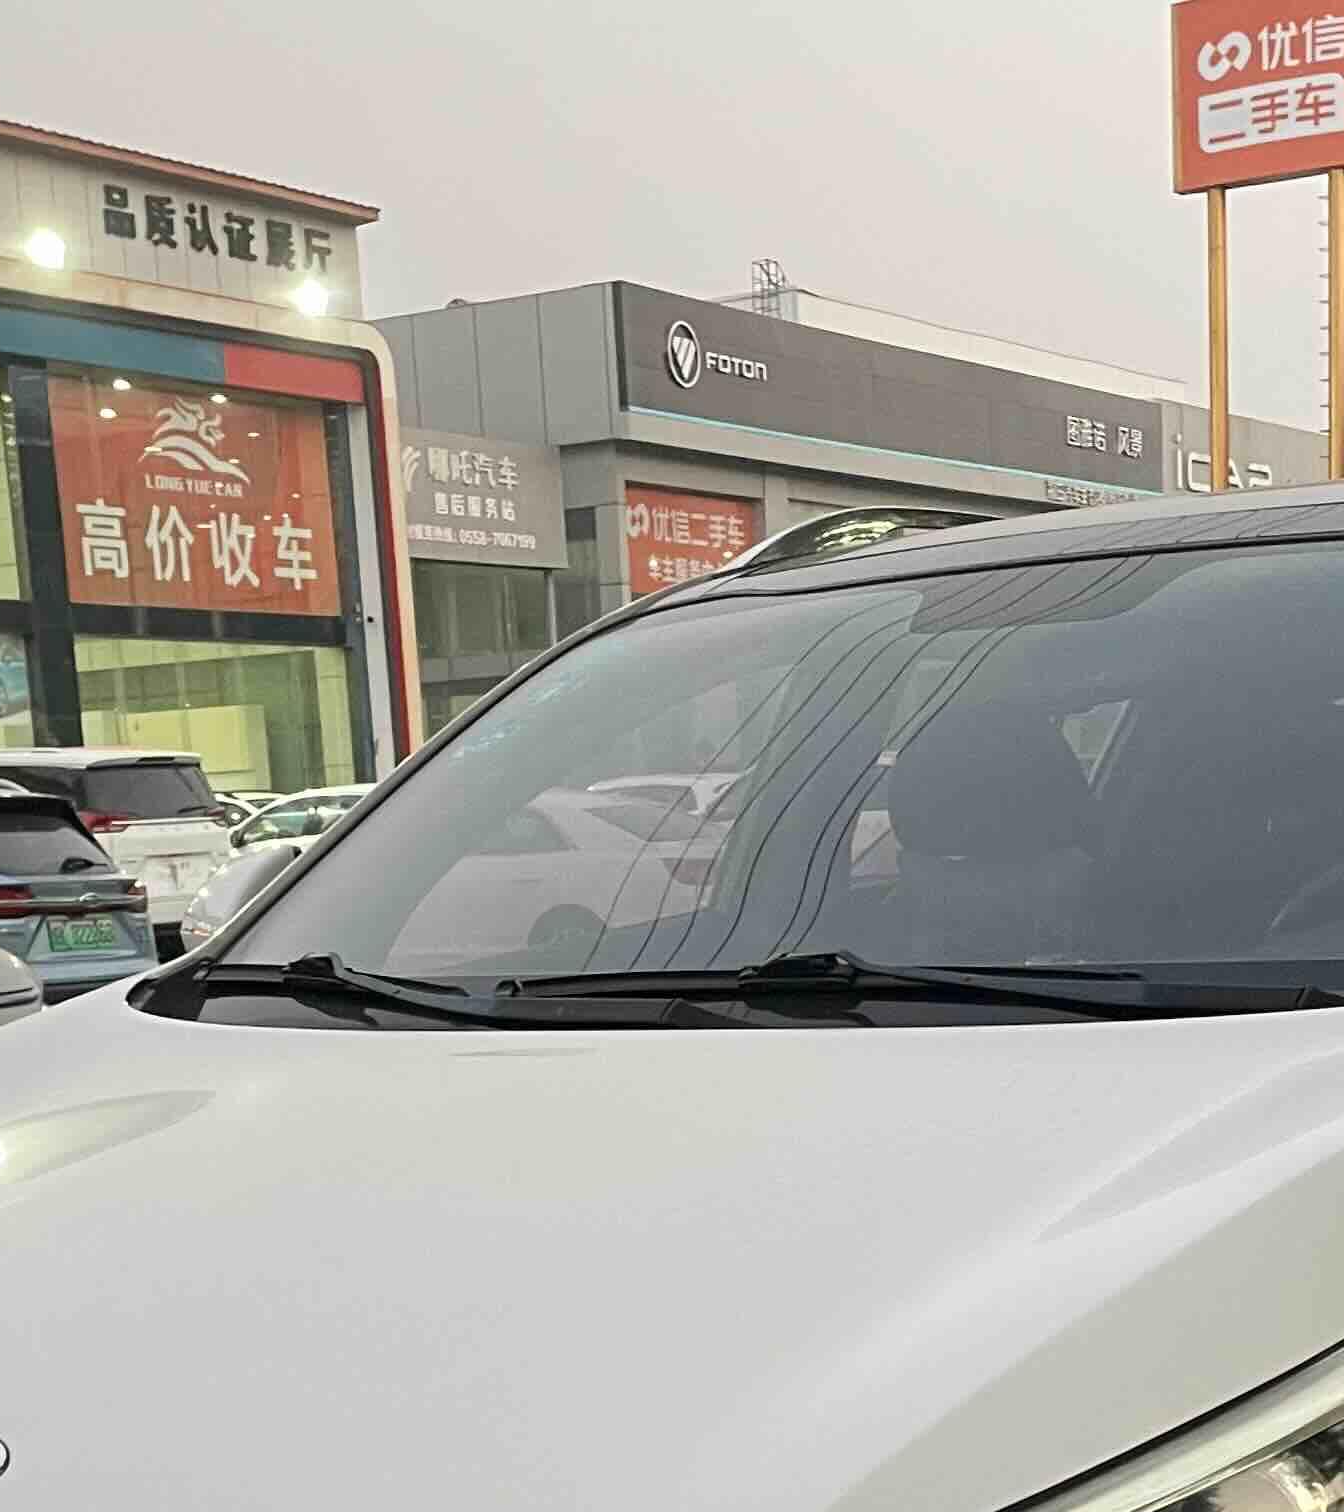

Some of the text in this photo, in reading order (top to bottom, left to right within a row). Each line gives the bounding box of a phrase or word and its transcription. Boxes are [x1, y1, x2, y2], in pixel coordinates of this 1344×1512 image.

[1208, 83, 1336, 145] 二手车
[103, 184, 332, 272] 品质认证展厅
[705, 351, 767, 381] FOTON
[427, 447, 519, 491] 哪吒汽车
[434, 492, 517, 521] 售后服务站
[651, 505, 745, 551] 优信二手车
[75, 497, 318, 590] 高价收车
